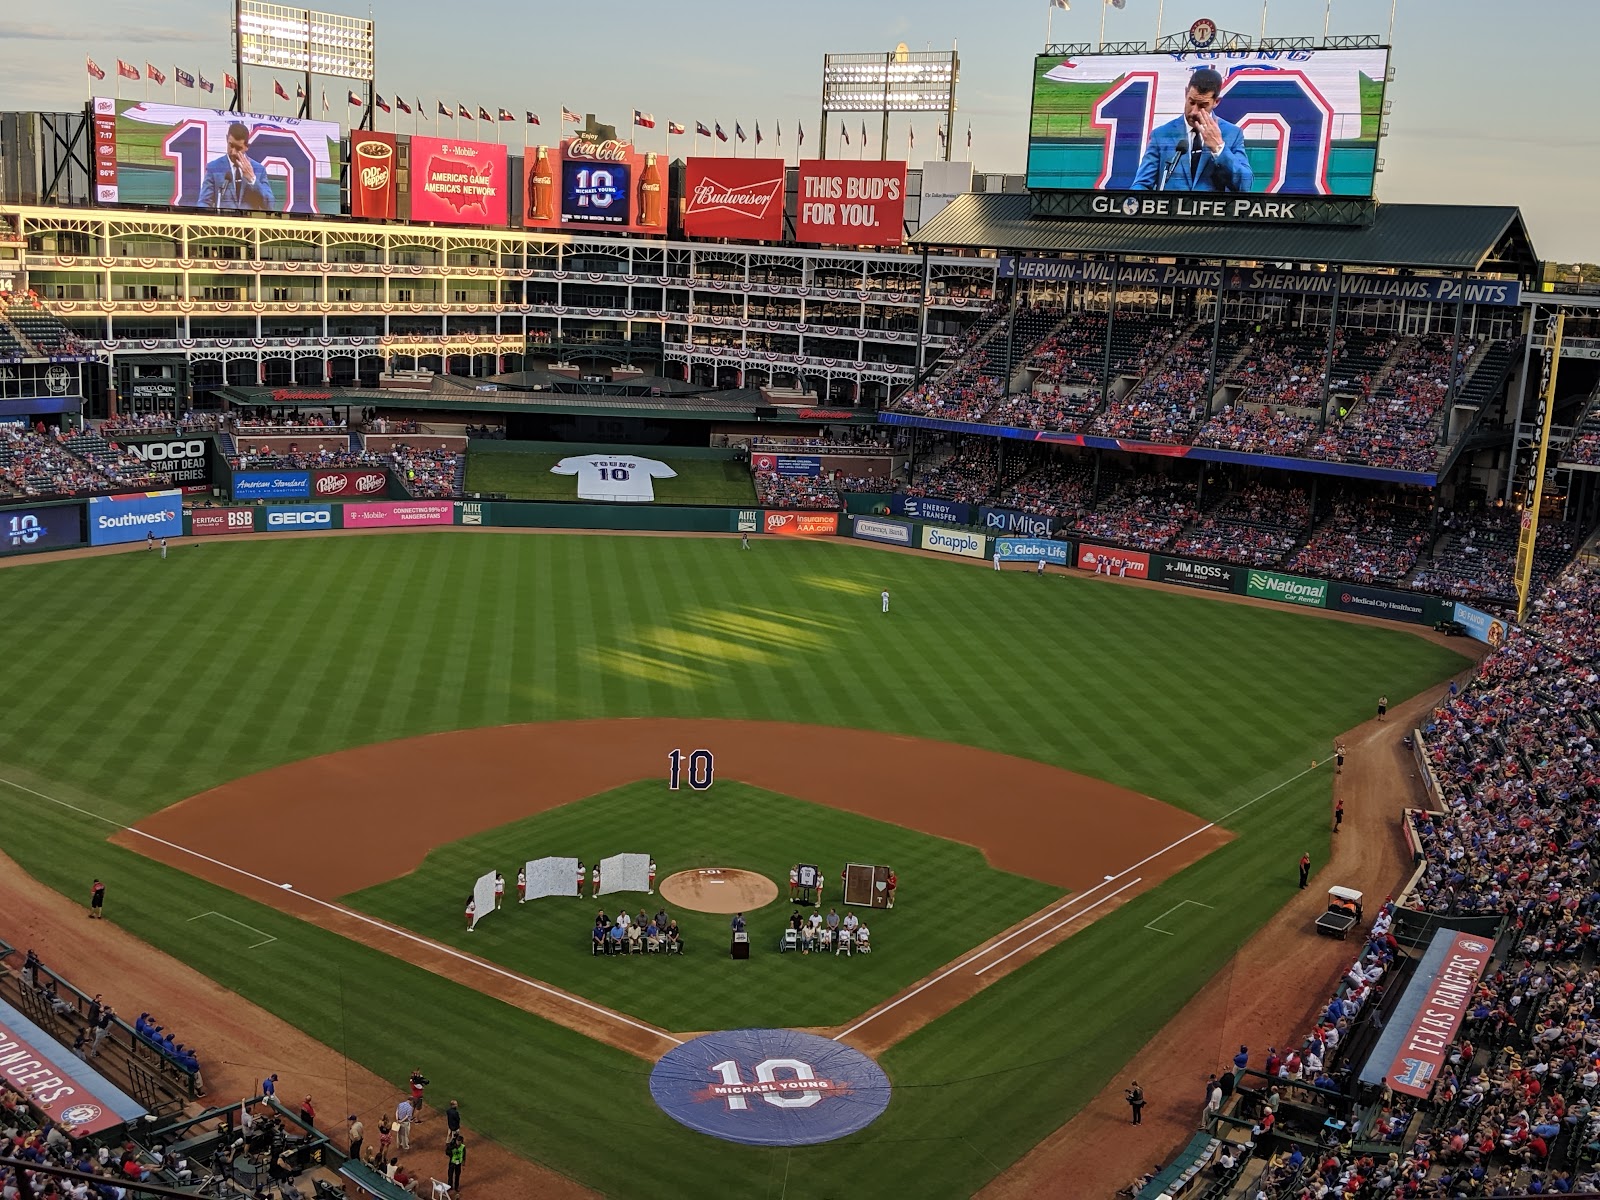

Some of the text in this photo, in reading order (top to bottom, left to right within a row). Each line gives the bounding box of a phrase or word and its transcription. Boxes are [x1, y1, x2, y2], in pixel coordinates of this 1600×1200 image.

[581, 132, 598, 140] Enjoy
[362, 168, 388, 188] Pepper
[370, 166, 382, 176] Dr
[432, 172, 490, 185] AMERICA'S GAME
[424, 182, 496, 196] AMERICA'S NETWORK
[576, 169, 614, 208] 10
[694, 184, 772, 206] Budweiser
[803, 176, 900, 201] THIS BUD'S
[802, 203, 880, 227] FOR YOU.
[1176, 198, 1226, 217] LIFE
[1233, 199, 1298, 219] PARK
[1163, 266, 1222, 287] PAINTS
[1436, 279, 1508, 304] PAINTS
[1541, 351, 1552, 392] EAT
[157, 384, 176, 392] CREEK
[1535, 400, 1546, 442] MOR
[127, 440, 205, 462] NOCO
[151, 458, 206, 472] START DEAD
[588, 461, 637, 469] YOUNG
[598, 468, 630, 482] 10
[236, 480, 270, 489] American
[320, 478, 345, 492] Pepper
[358, 477, 384, 491] Pepper
[462, 504, 482, 513] ALTEC
[922, 502, 950, 513] ENERGY
[98, 511, 167, 529] Southwest
[228, 511, 252, 526] BSB
[268, 511, 330, 525] GEICO
[738, 511, 756, 520] ALTEC
[797, 515, 834, 523] Insurance
[922, 510, 957, 522] TRANSFER
[10, 515, 38, 546] 10
[1008, 514, 1052, 536] Mitel
[929, 530, 978, 552] Snapple
[1014, 544, 1067, 558] Globe Life
[1174, 562, 1221, 577] JIM ROSS
[1298, 595, 1321, 604] Rental
[1352, 596, 1423, 614] Medical City Healthcare
[1467, 612, 1485, 625] FAVOR
[668, 748, 714, 790] 10
[1431, 954, 1481, 1010] RANGERS
[1408, 1008, 1456, 1056] TEXAS
[712, 1058, 822, 1110] 10
[714, 1080, 828, 1094] MICHAEL YOUNG
